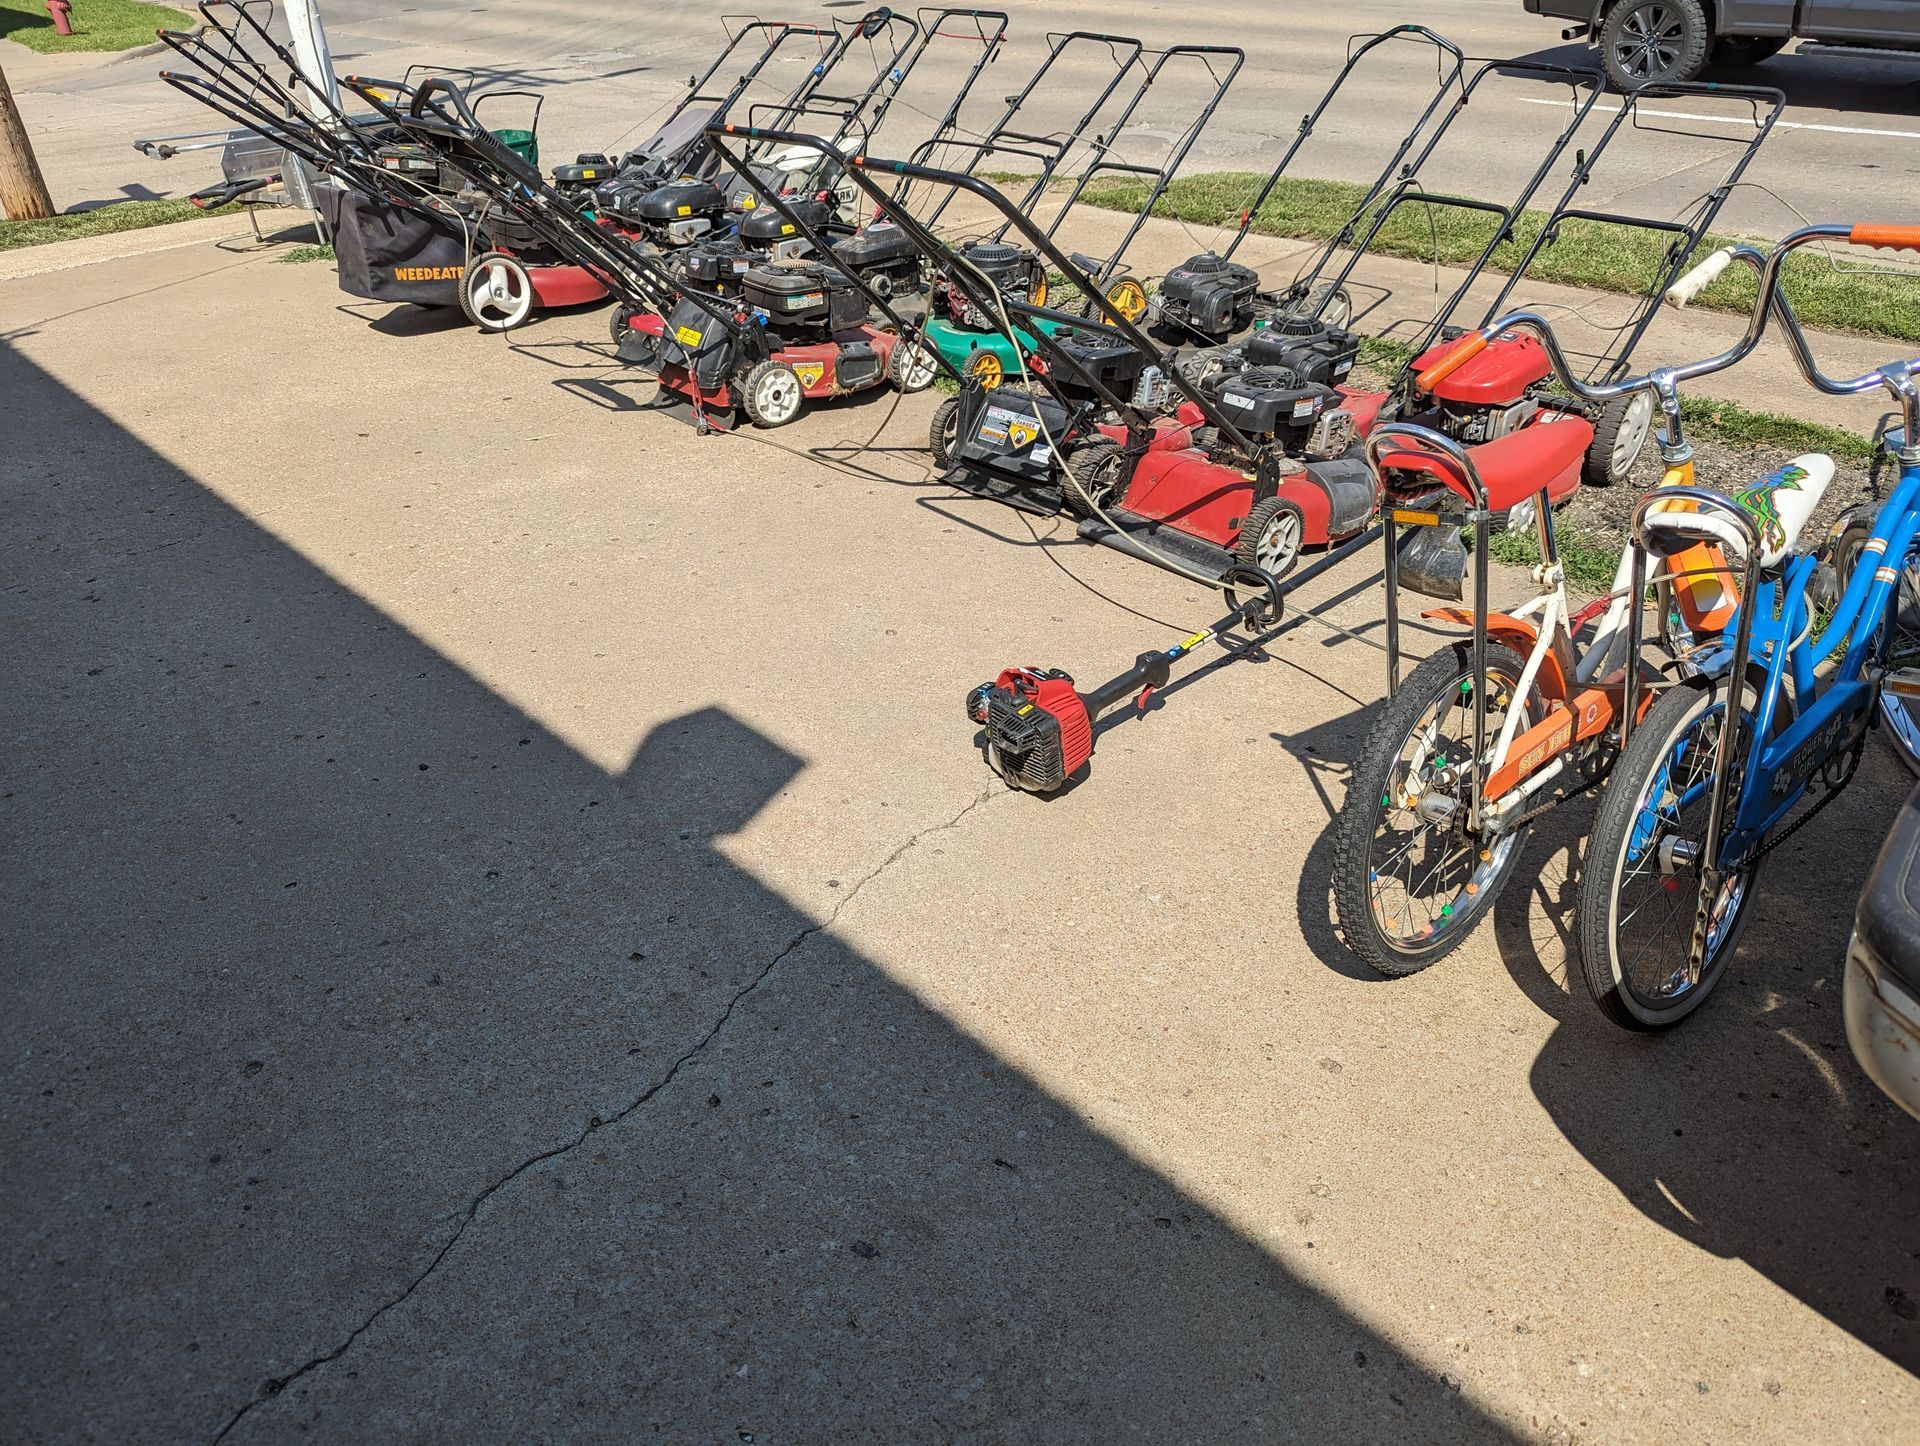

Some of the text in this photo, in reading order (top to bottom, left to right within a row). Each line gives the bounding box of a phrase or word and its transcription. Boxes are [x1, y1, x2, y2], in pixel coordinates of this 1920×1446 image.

[394, 266, 465, 281] WEEDEATE
[1793, 731, 1824, 769] FLOWER
[1799, 752, 1816, 777] GIRL
